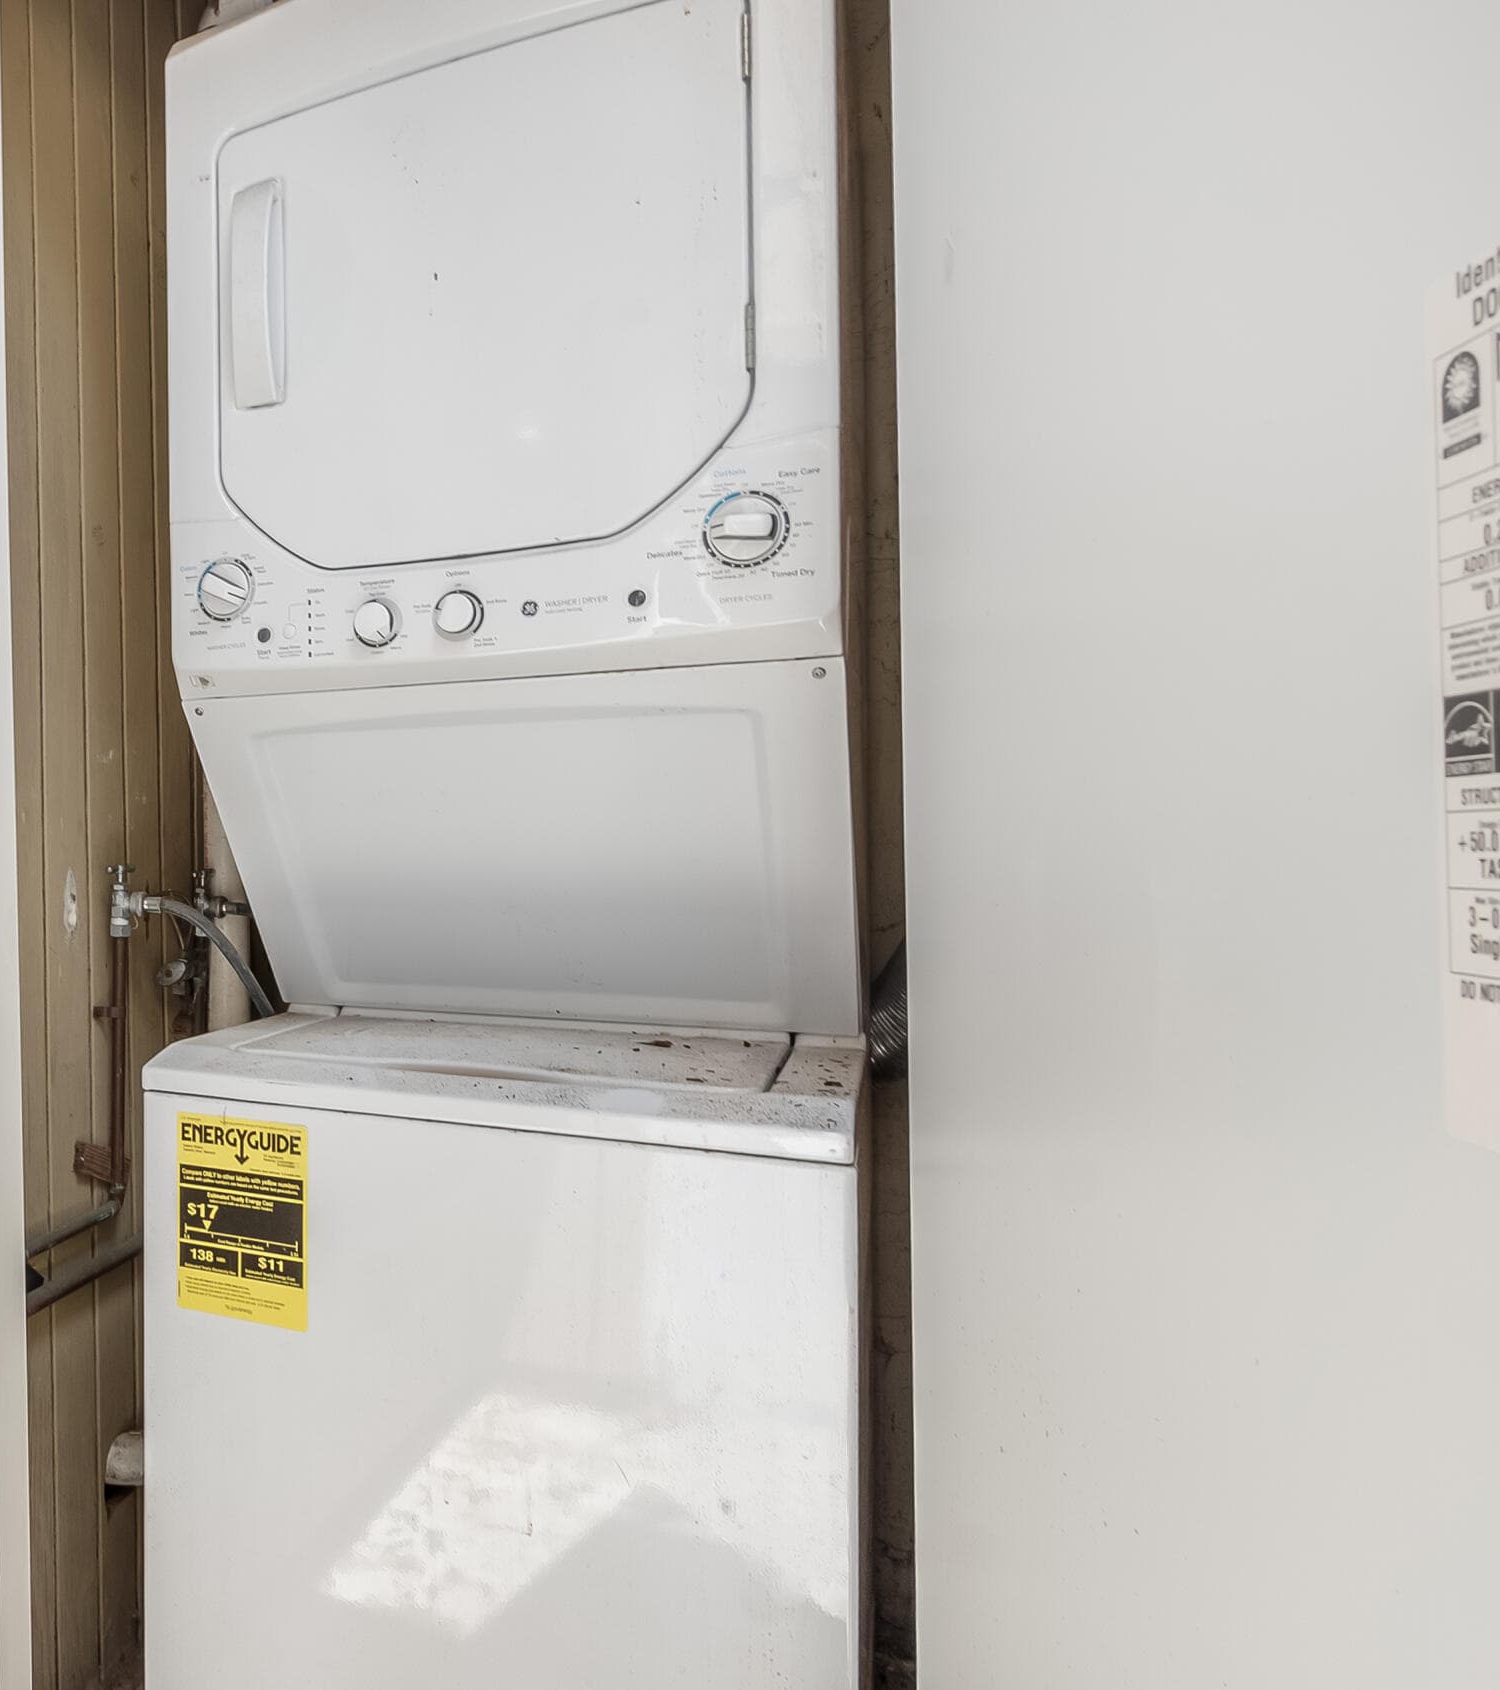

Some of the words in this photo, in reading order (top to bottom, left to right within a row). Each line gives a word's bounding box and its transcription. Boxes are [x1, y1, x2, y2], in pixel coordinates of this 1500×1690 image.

[1473, 287, 1500, 326] DO
[627, 615, 647, 623] Start
[181, 1122, 301, 1157] ENERGYGUIDE
[187, 1202, 219, 1220] $17
[189, 1248, 213, 1263] 138
[257, 1257, 284, 1273] $11
